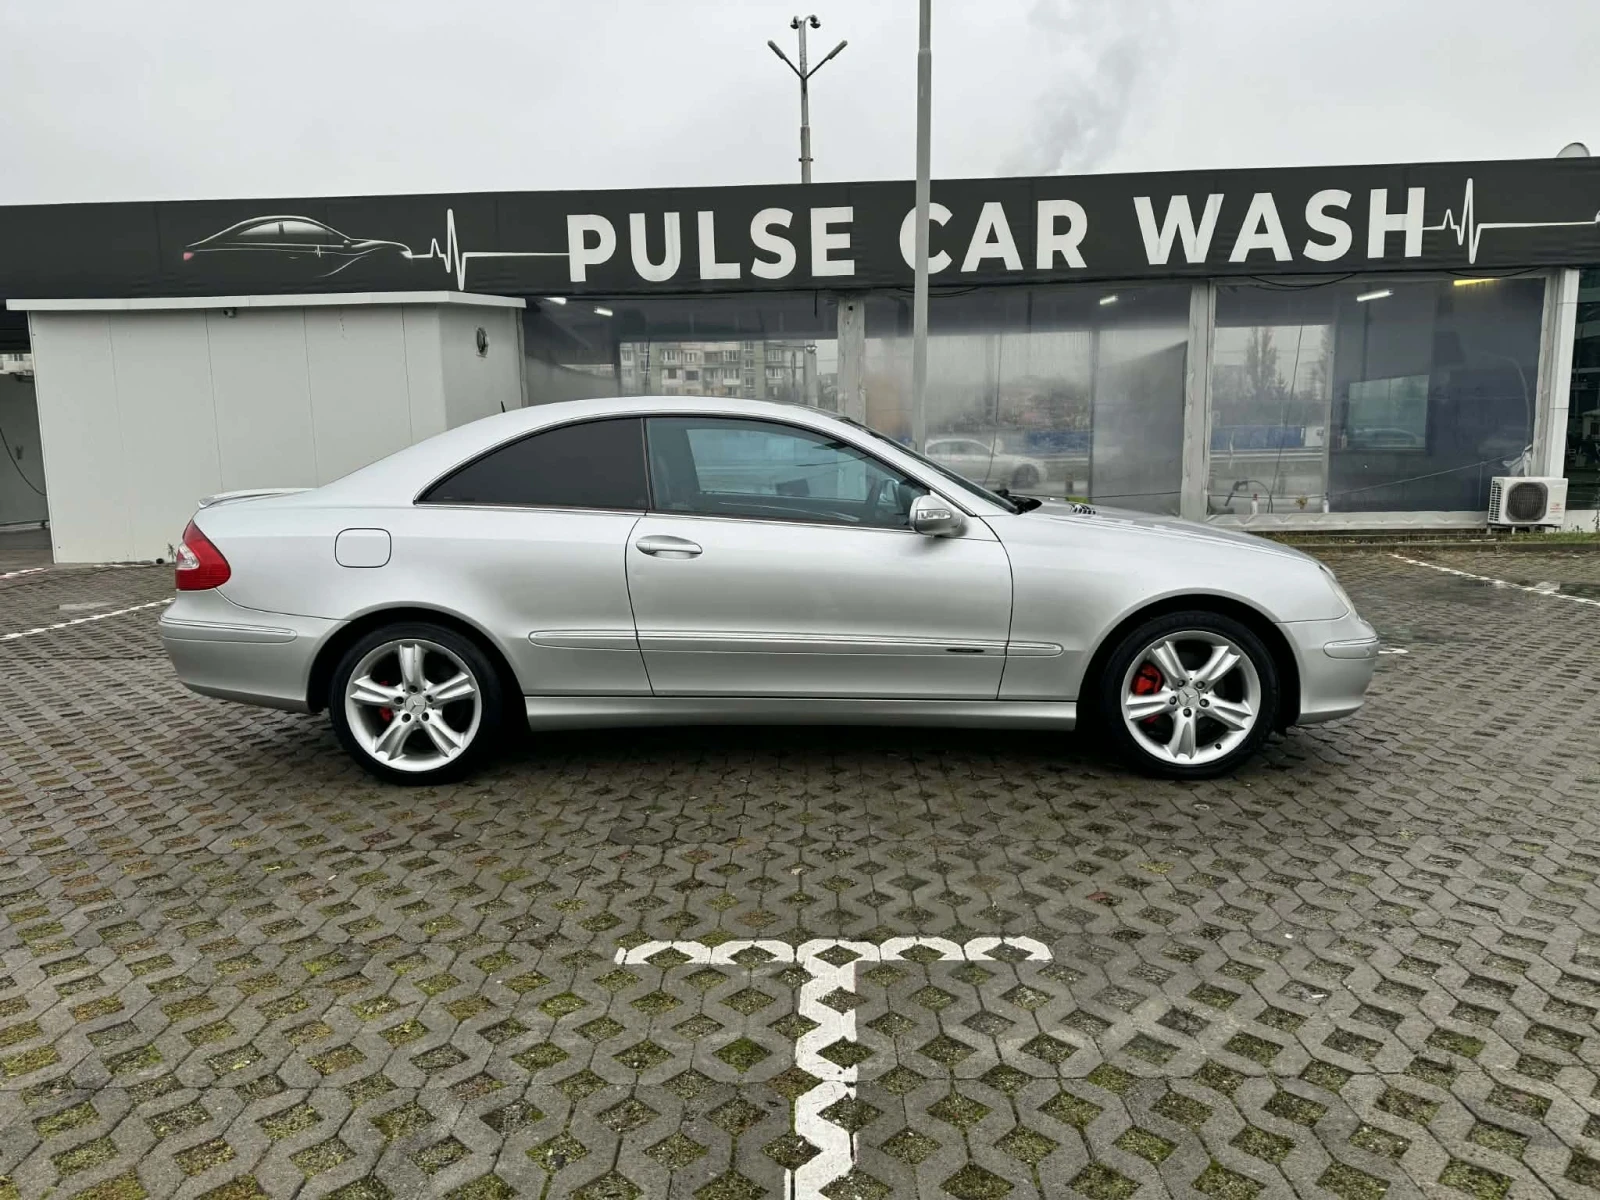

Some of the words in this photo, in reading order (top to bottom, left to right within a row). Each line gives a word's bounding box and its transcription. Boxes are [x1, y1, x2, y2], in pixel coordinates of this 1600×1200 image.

[567, 207, 855, 283] PULSE
[899, 200, 1088, 275] CAR
[1133, 187, 1426, 265] WASH
